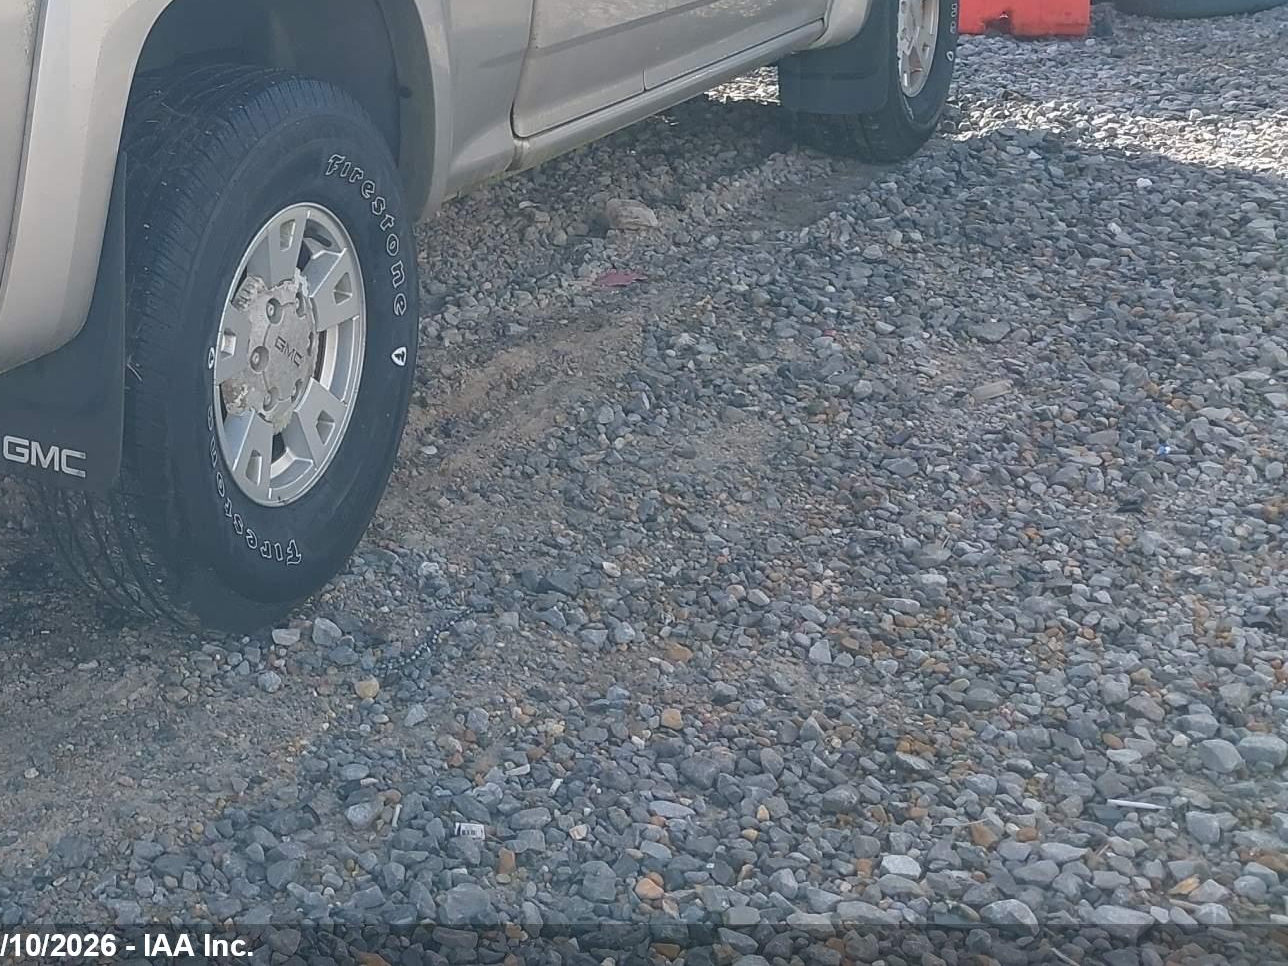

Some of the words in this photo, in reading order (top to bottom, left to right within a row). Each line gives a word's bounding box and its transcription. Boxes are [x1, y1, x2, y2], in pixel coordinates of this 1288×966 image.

[325, 153, 408, 318] Firestone
[274, 335, 305, 368] GMC
[2, 434, 87, 478] GMC
